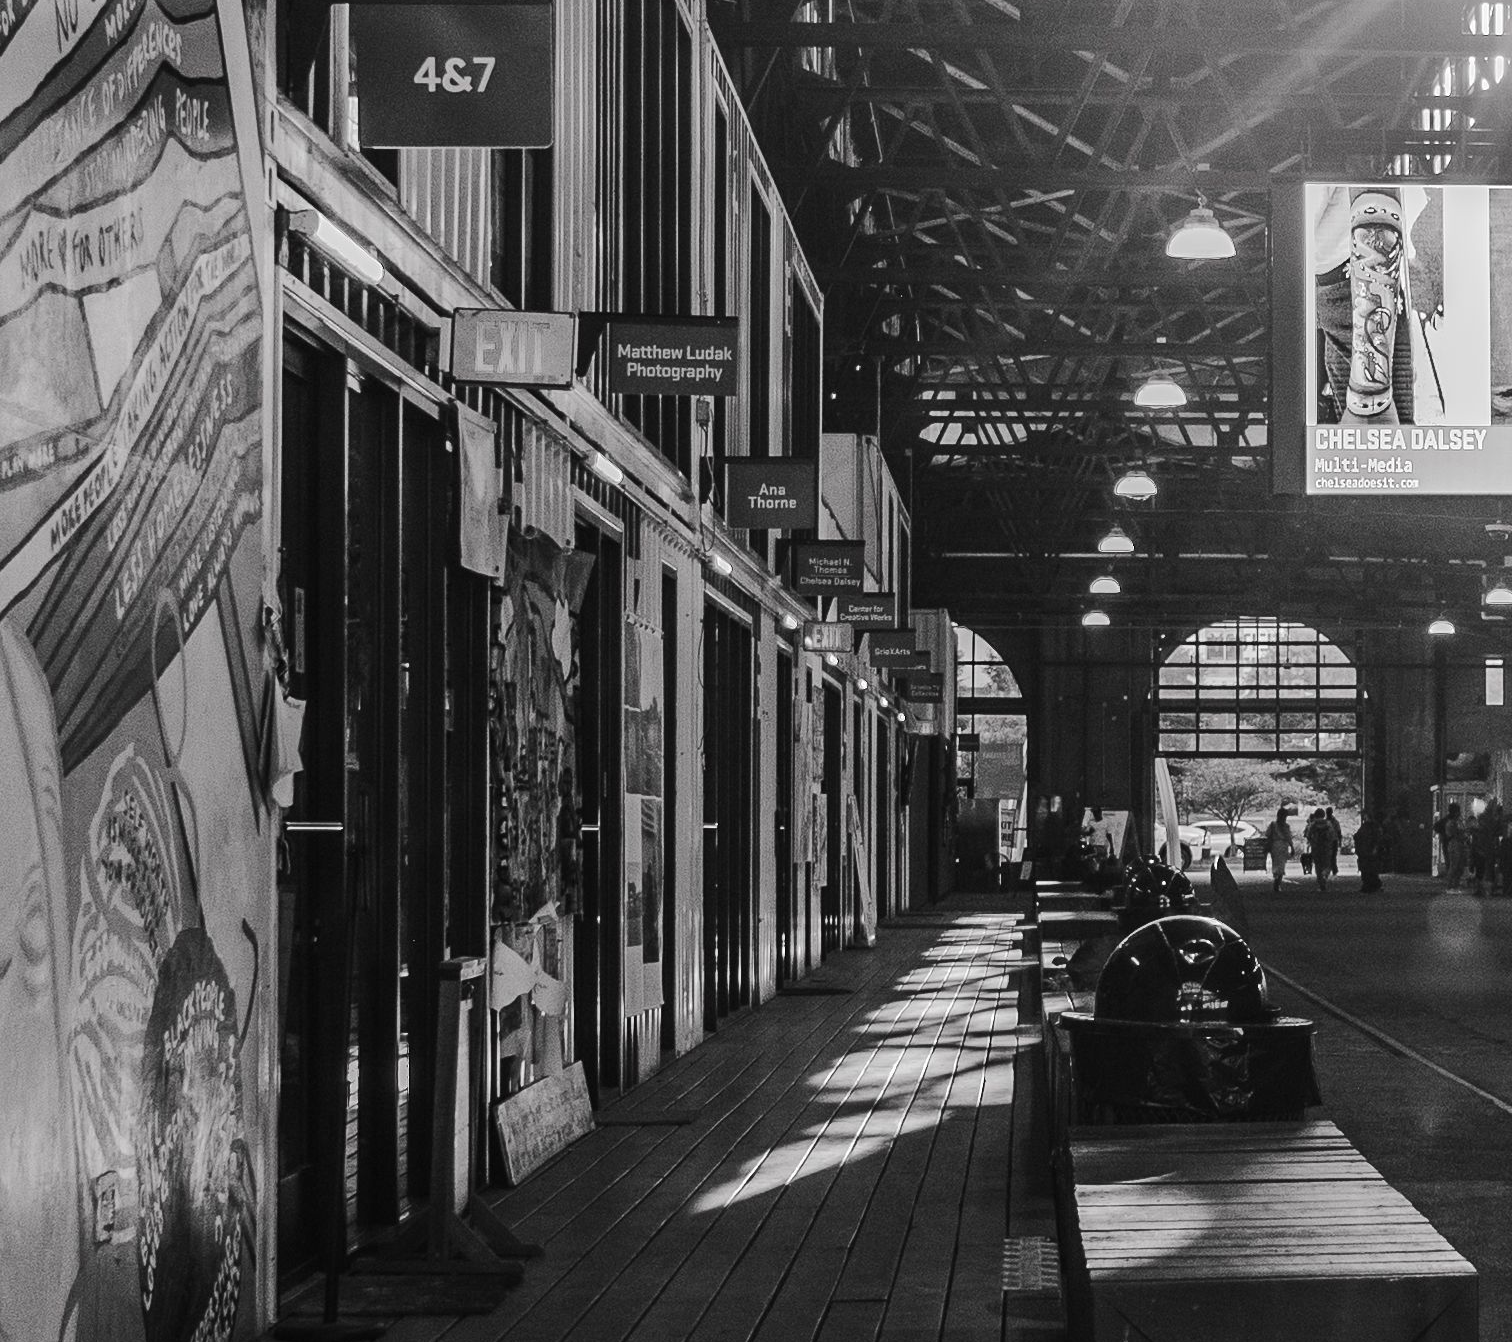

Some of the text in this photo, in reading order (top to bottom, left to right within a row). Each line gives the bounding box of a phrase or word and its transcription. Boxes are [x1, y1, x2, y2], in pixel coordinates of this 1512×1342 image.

[413, 54, 497, 95] 4&7
[174, 87, 211, 142] PEOPLE
[19, 227, 55, 289] MORE
[72, 230, 94, 272] FOR
[473, 320, 550, 375] EXIT
[617, 343, 734, 363] Matthew Ludak
[625, 361, 724, 383] Photography
[1315, 429, 1488, 451] CHELSEA DALSEY
[1314, 456, 1414, 474] Multi-Media
[758, 483, 787, 496] Ana
[1315, 475, 1420, 490] chelseadoesit.com
[747, 496, 798, 510] Thorne
[50, 495, 83, 552] MORE
[808, 557, 842, 567] Michael
[115, 539, 145, 620] LESS
[799, 577, 833, 587] Chelsea
[813, 630, 842, 645] EXIT
[163, 990, 196, 1062] BLACK
